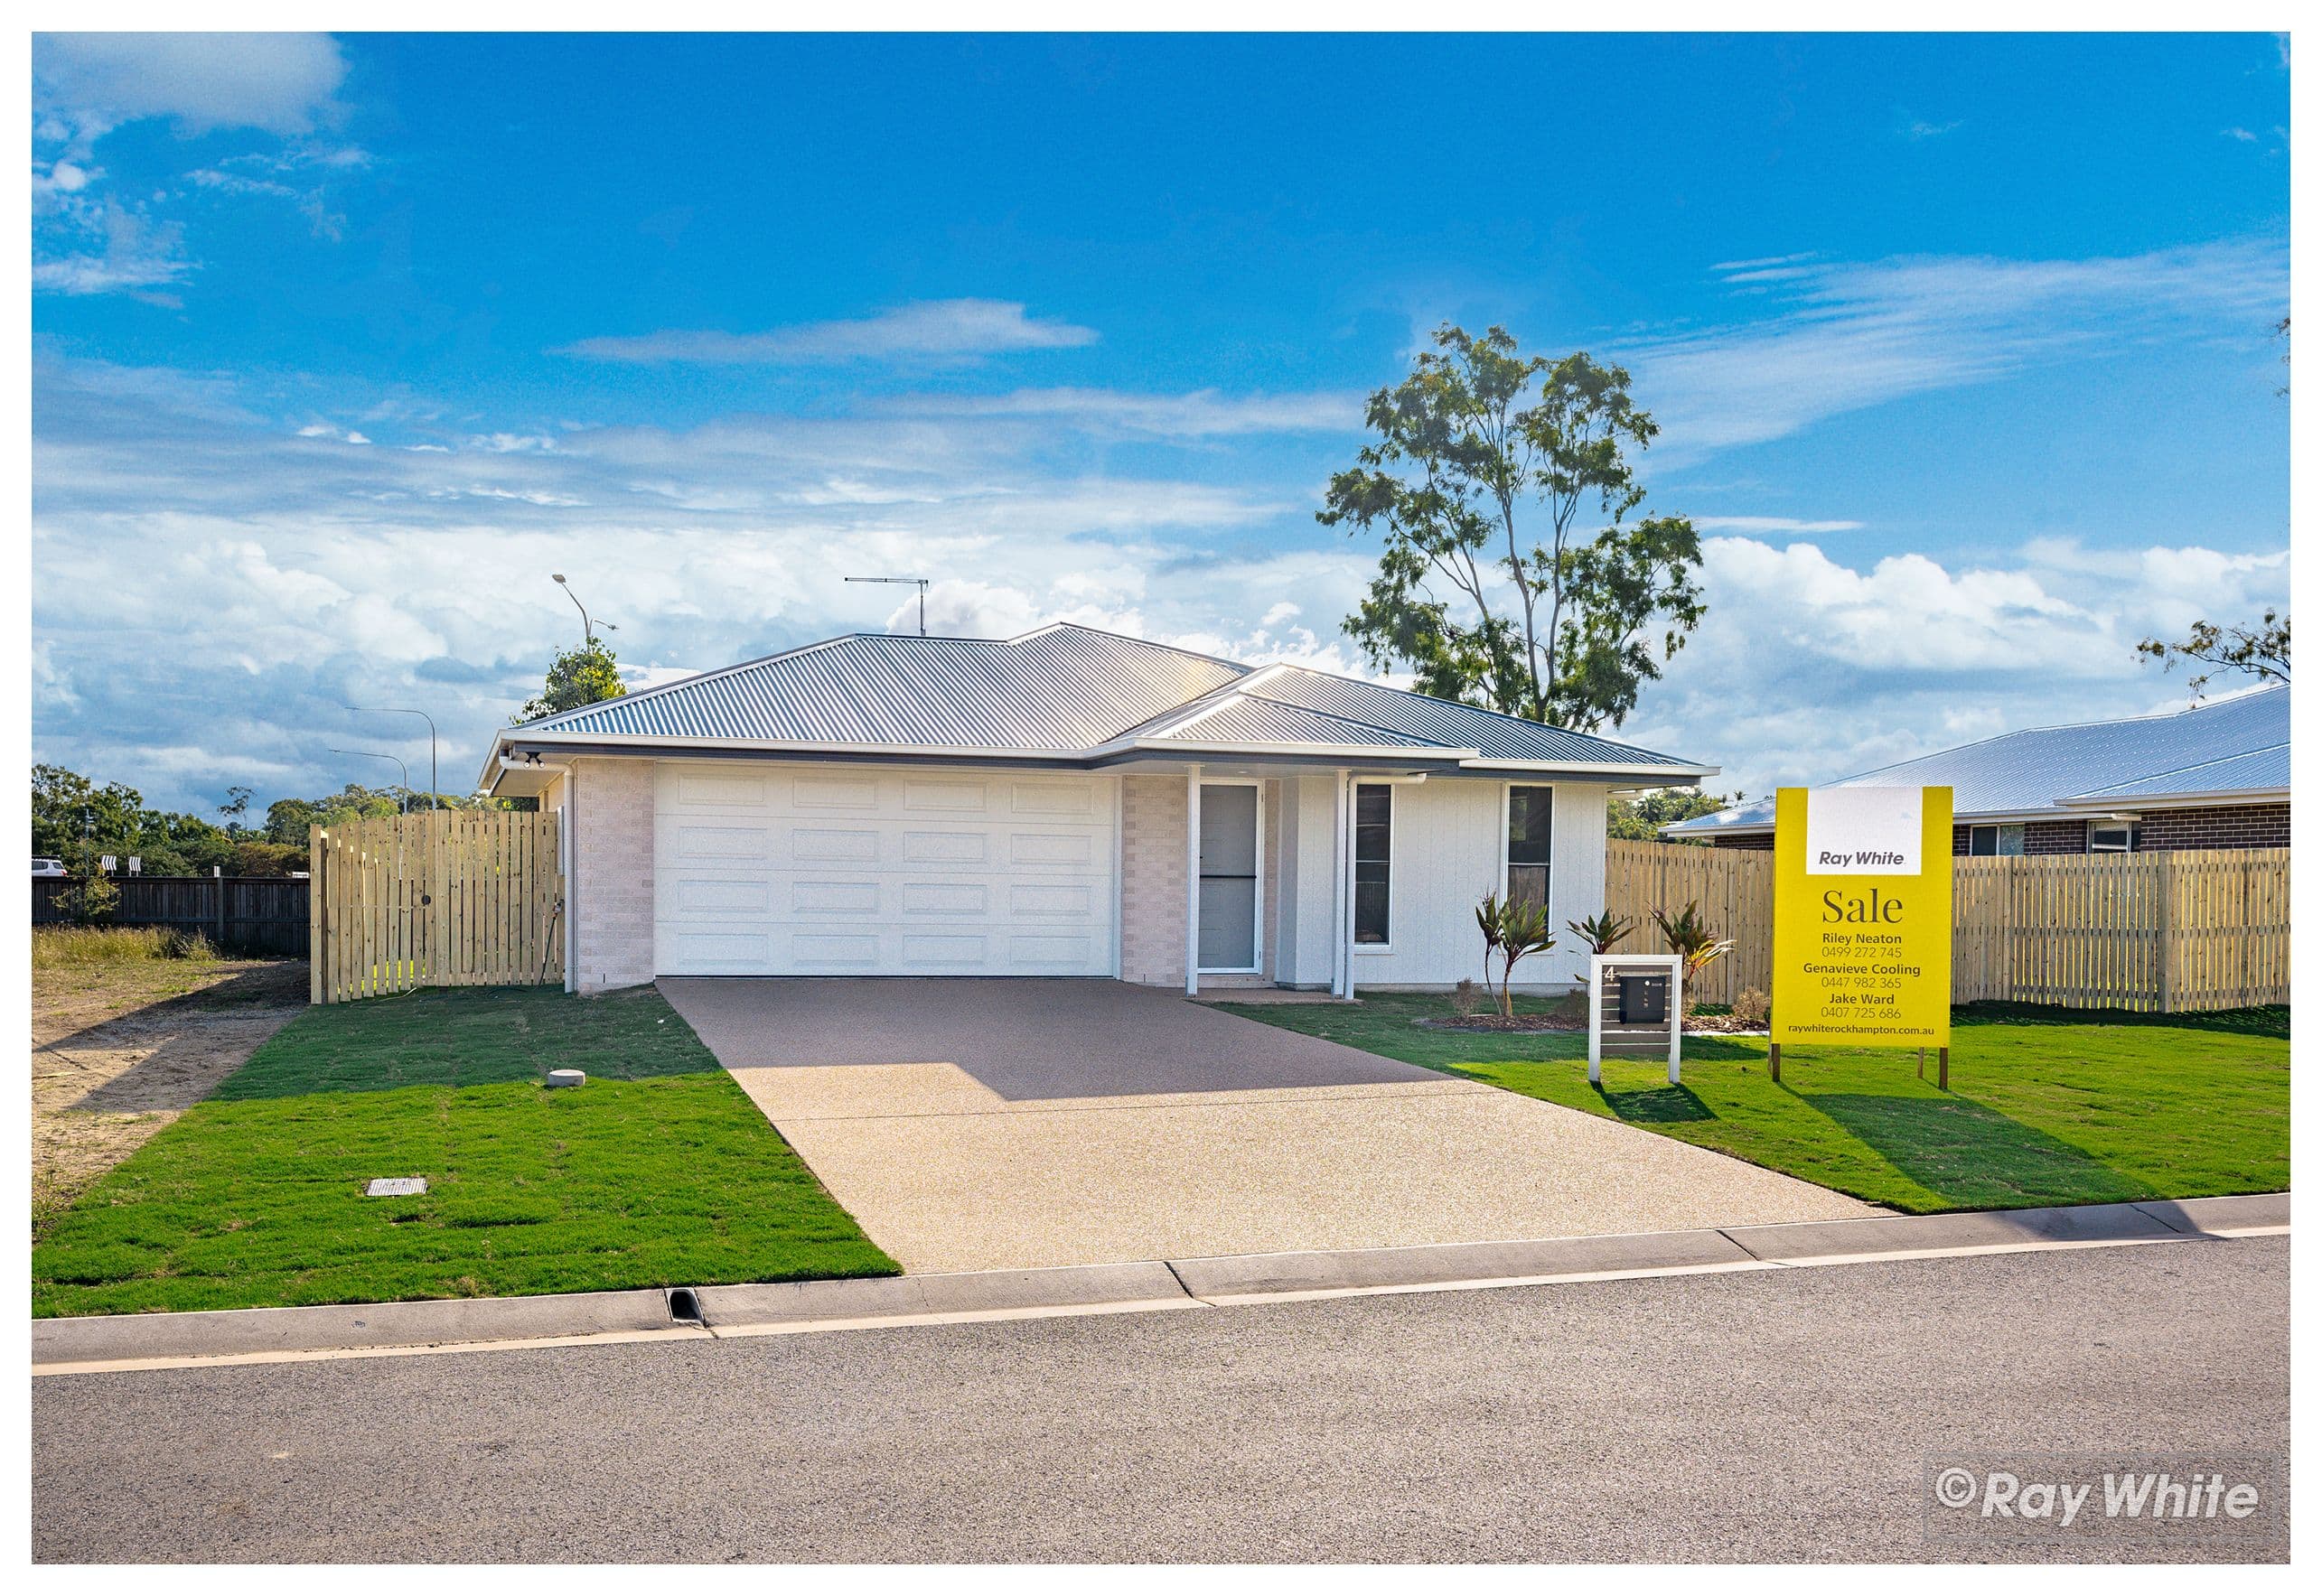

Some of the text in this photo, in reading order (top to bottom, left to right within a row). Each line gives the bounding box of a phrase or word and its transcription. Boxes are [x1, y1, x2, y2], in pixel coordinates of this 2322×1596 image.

[1819, 851, 1905, 867] Ray White
[1822, 888, 1904, 924] Sale
[1822, 932, 1902, 946] Riley Neaton
[1821, 947, 1902, 958] 0499 272 745
[1605, 966, 1615, 982] 4
[1803, 963, 1921, 977] Genavieve Cooling
[1821, 977, 1902, 989] 0447 982 365
[1830, 994, 1895, 1005] Jake Ward
[1821, 1007, 1902, 1020] 0407 725 686
[1788, 1023, 1934, 1036] raywhiterockhampton.com.au
